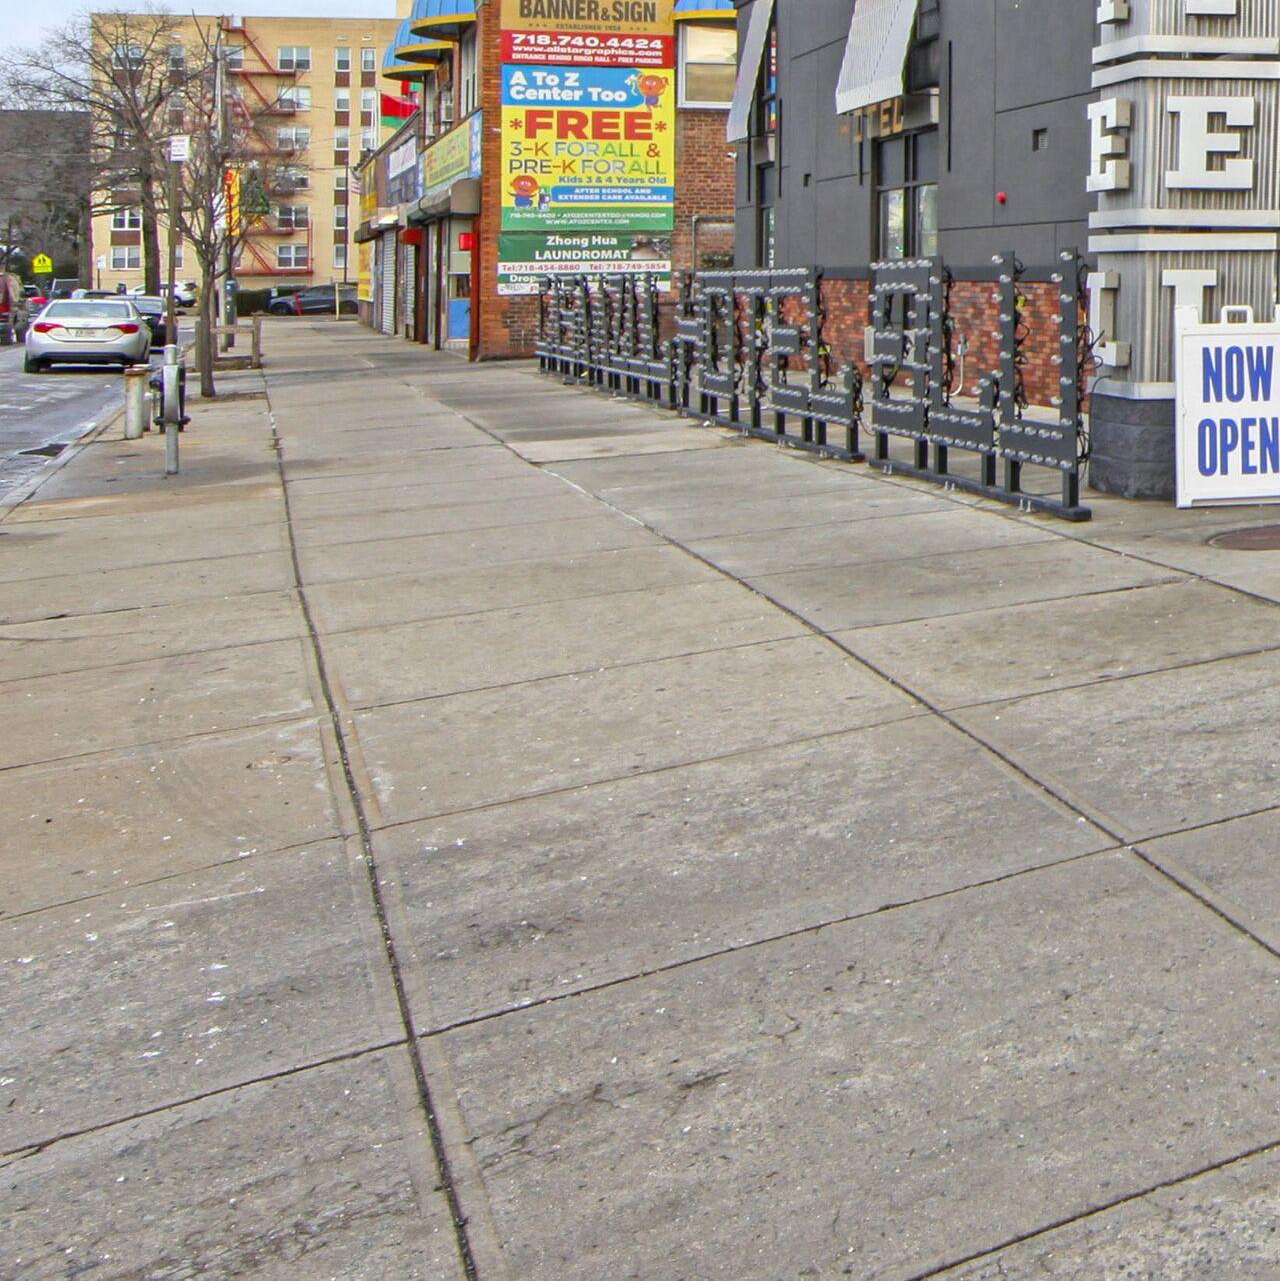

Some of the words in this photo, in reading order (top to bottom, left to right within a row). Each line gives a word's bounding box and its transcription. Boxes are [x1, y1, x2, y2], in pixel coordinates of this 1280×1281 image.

[511, 33, 663, 49] 718.740.4424
[512, 45, 662, 57] www.allstargraphics.com
[510, 71, 528, 86] A
[532, 72, 560, 86] To
[564, 72, 580, 87] Z
[510, 86, 583, 102] Center
[587, 88, 627, 102] Too
[525, 110, 654, 141] FREE
[510, 142, 549, 157] 3-K
[555, 143, 599, 157] FOR
[602, 143, 641, 158] ALL
[646, 143, 660, 158] &
[509, 159, 577, 174] PRE-K
[582, 160, 625, 174] FOR
[628, 160, 667, 175] ALL
[586, 176, 593, 184] 3
[595, 176, 603, 184] &
[605, 176, 613, 184] 4
[616, 176, 645, 184] Years
[546, 236, 588, 248] Zhong
[592, 236, 617, 245] Hua
[535, 250, 629, 260] LAUNDROMAT
[1202, 346, 1274, 403] NOW
[1198, 417, 1280, 477] OPEN
